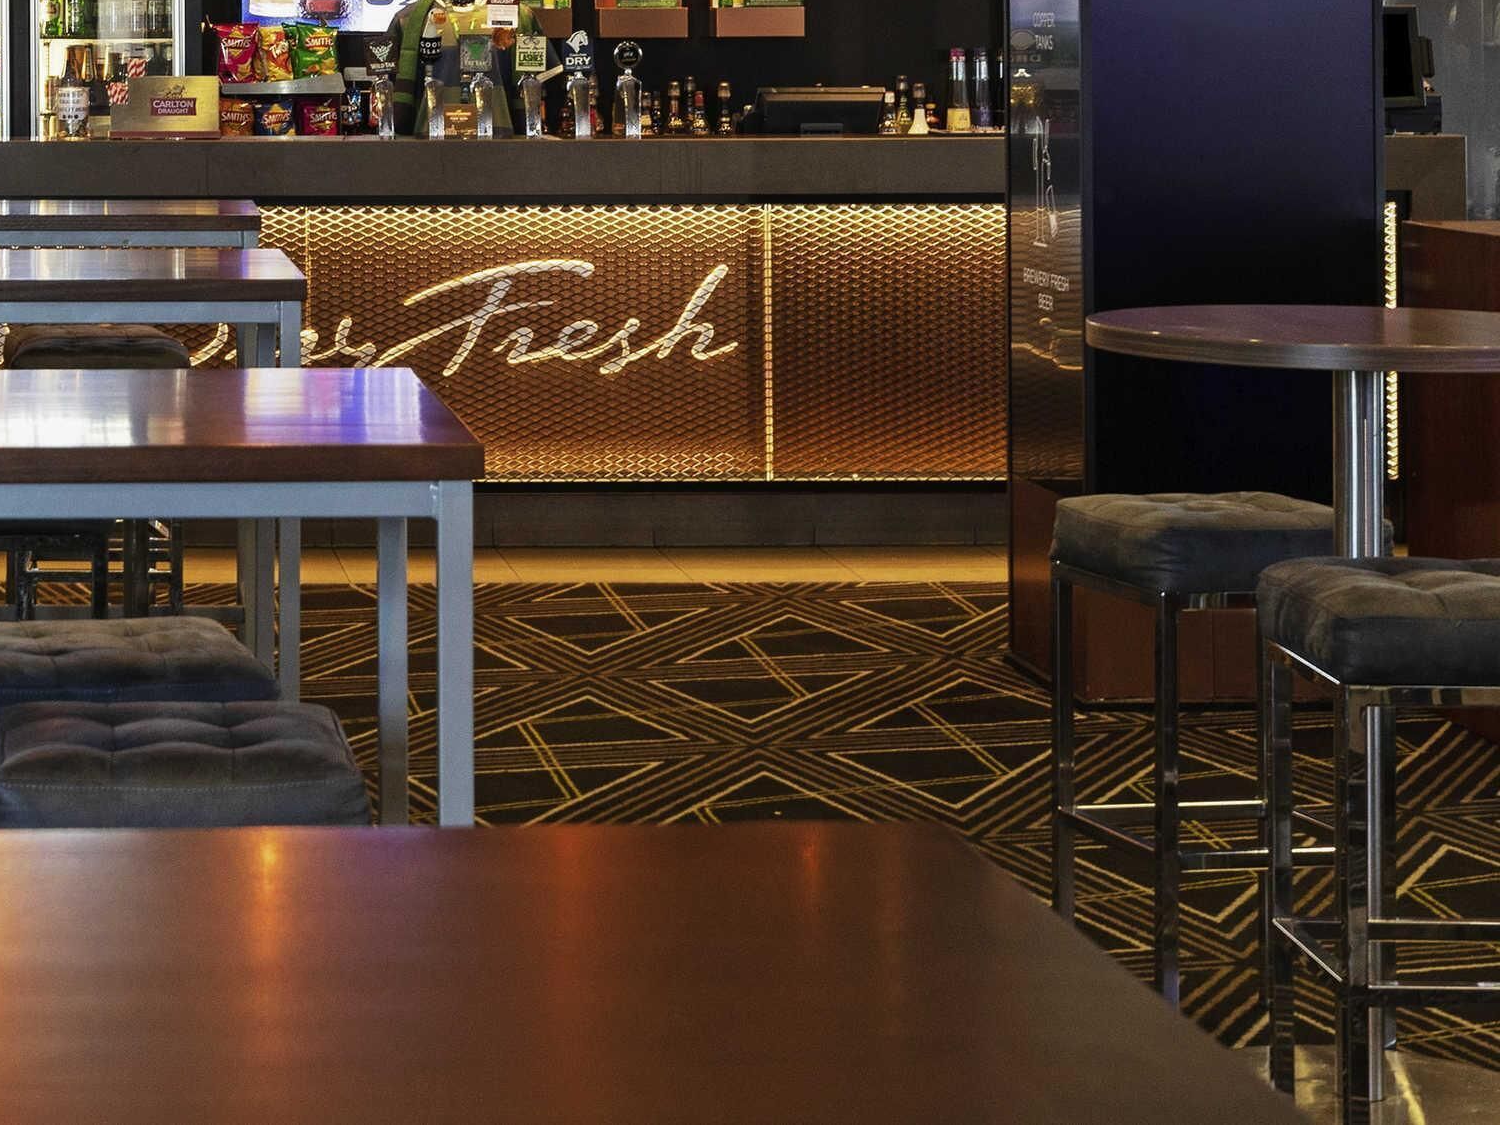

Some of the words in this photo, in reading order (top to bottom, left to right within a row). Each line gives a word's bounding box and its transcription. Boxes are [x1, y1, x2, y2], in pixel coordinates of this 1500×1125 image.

[1035, 35, 1053, 50] TANKS
[519, 54, 544, 62] LASHES
[565, 56, 591, 66] DRY
[152, 100, 195, 109] CARLTON
[1023, 267, 1049, 287] BREWERY
[1038, 292, 1054, 311] BEER
[385, 259, 739, 375] Fresh
